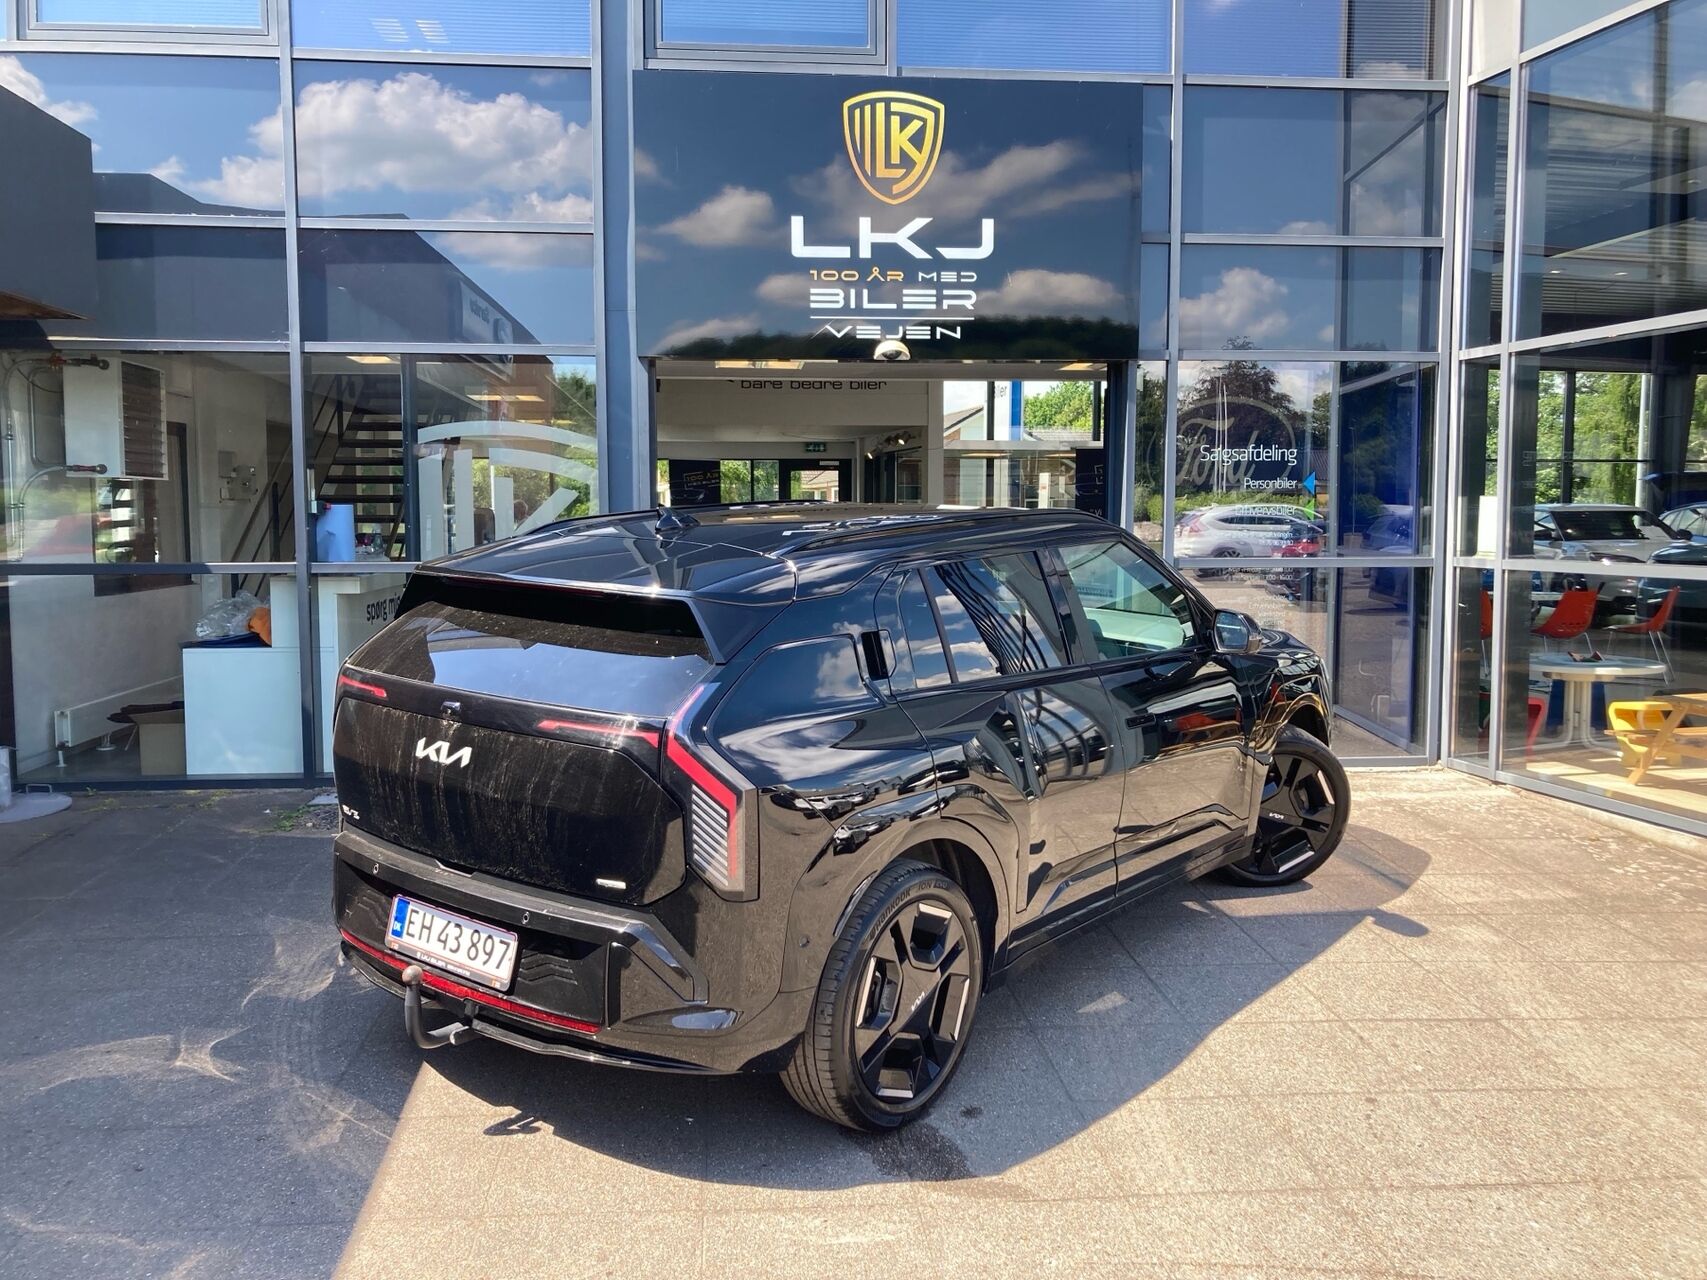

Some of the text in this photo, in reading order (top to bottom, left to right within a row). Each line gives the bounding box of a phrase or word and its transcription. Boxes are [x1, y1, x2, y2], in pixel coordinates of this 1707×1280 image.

[791, 215, 995, 259] LKJ
[809, 267, 978, 282] 100 ÅR MED
[809, 288, 978, 310] BILER
[823, 325, 962, 340] VEJEN
[1200, 444, 1298, 466] Salgsafdeling
[1243, 477, 1298, 489] Personbiler
[415, 737, 472, 768] KIA
[405, 908, 435, 943] EH
[437, 919, 463, 954] 43
[467, 929, 511, 969] 897
